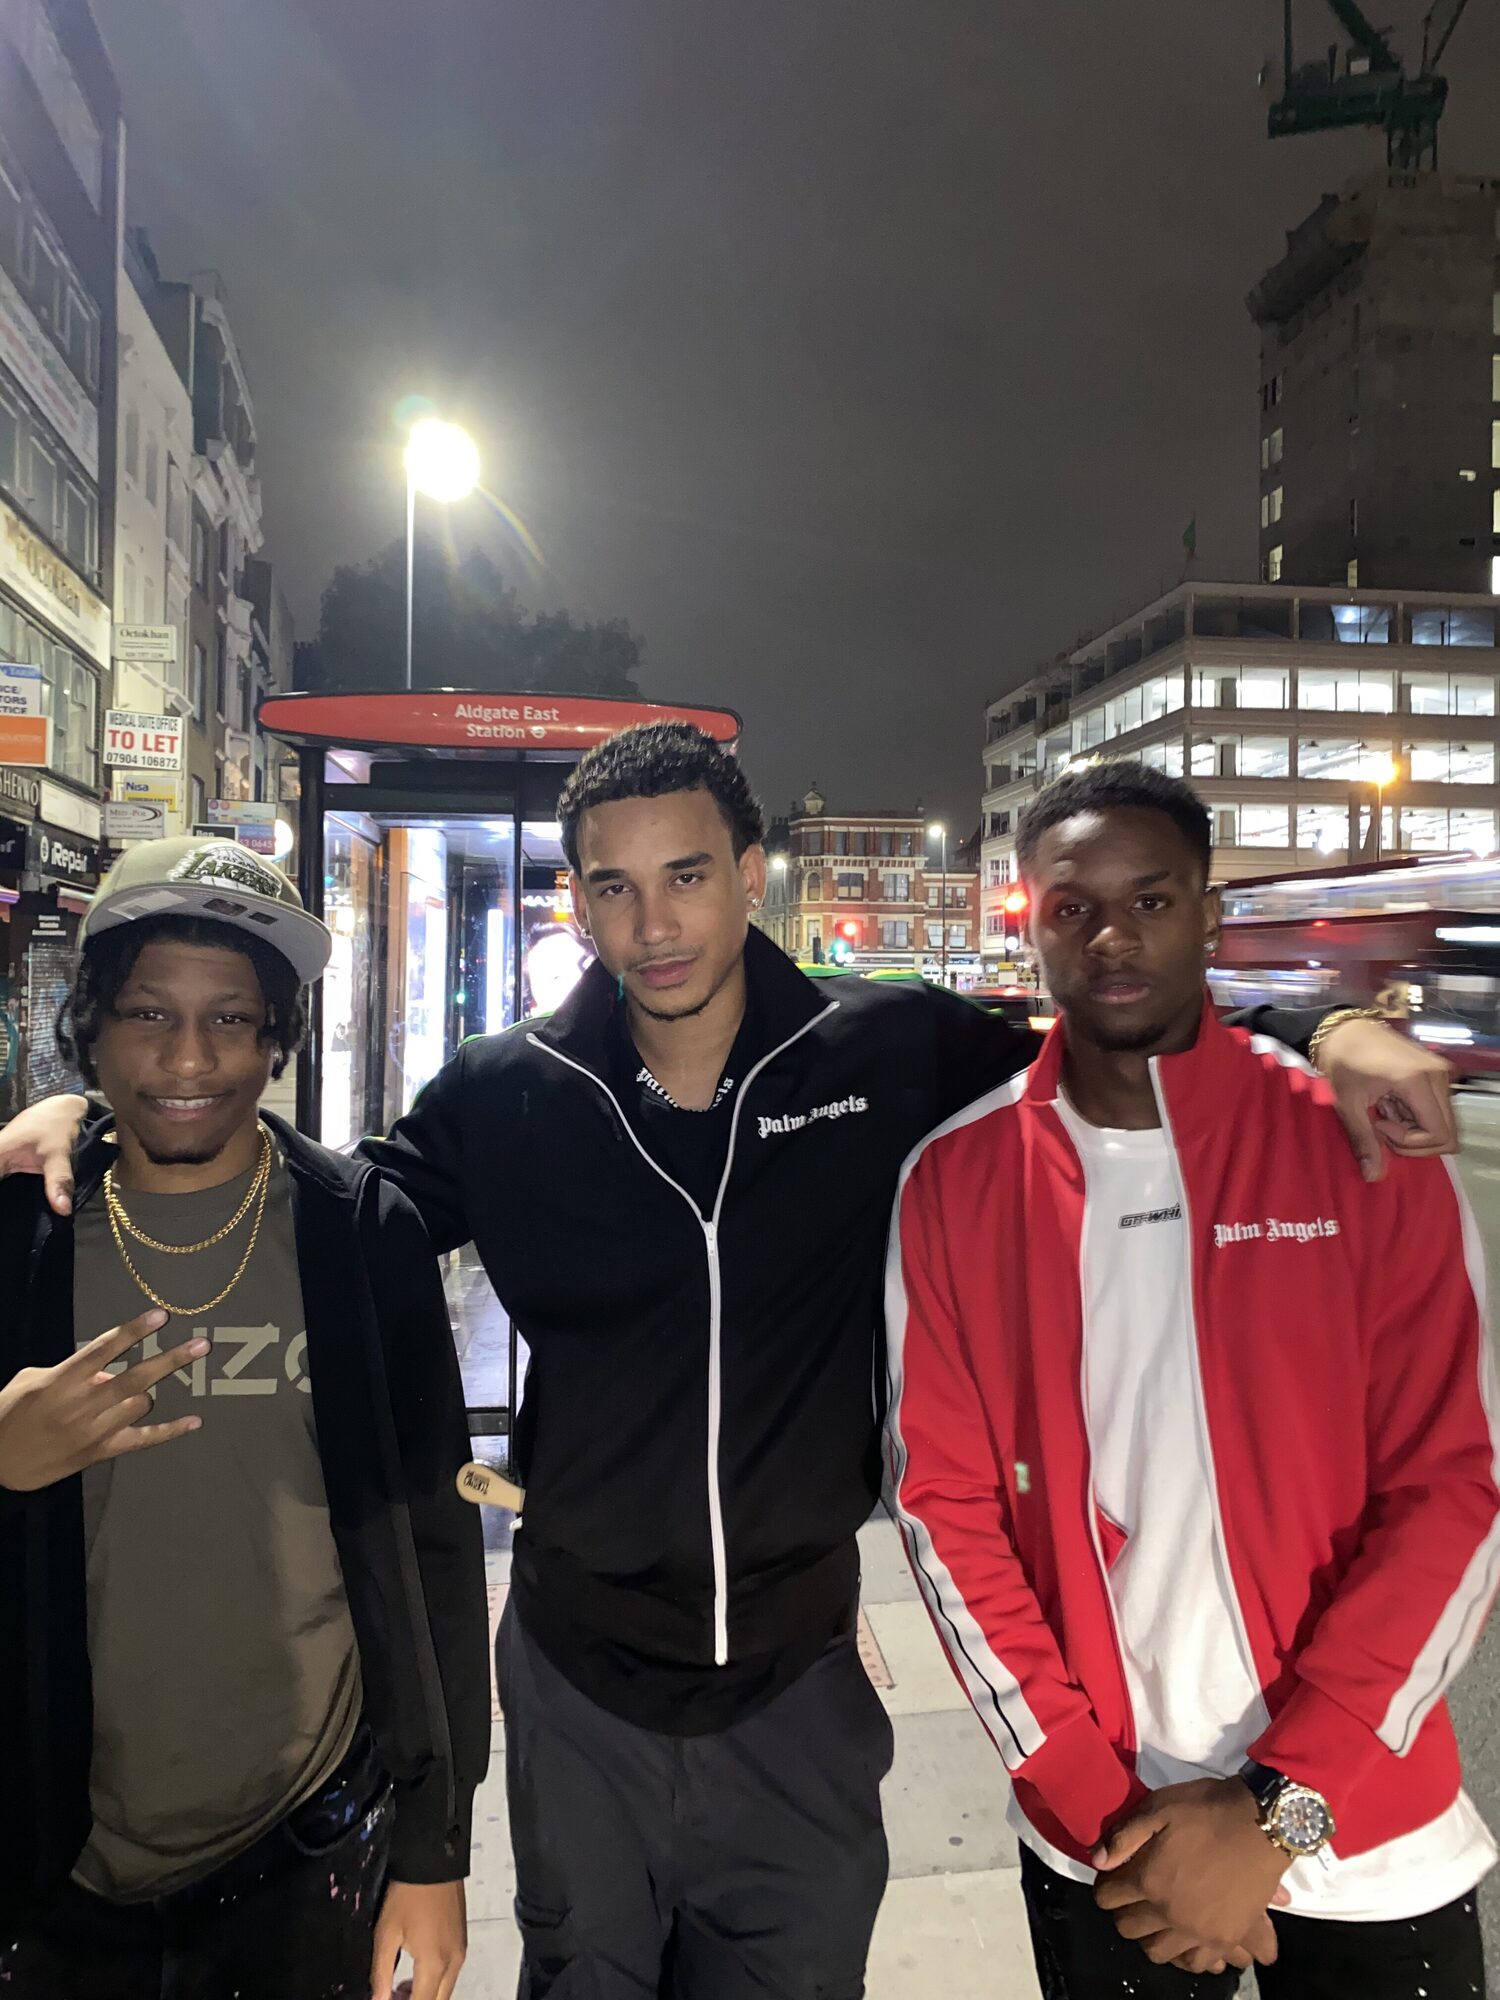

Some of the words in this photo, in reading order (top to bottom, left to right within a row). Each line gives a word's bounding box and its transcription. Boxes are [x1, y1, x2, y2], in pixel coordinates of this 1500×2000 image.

[454, 703, 519, 722] Aldgate
[523, 705, 560, 721] East
[108, 729, 134, 750] TO
[142, 733, 179, 753] LET
[466, 723, 525, 738] Station
[106, 752, 138, 764] 07904
[141, 756, 178, 768] 106872
[126, 781, 149, 792] Nisa
[51, 841, 88, 874] iRepair
[757, 1113, 807, 1139] Palm
[1265, 1217, 1340, 1243] Angels
